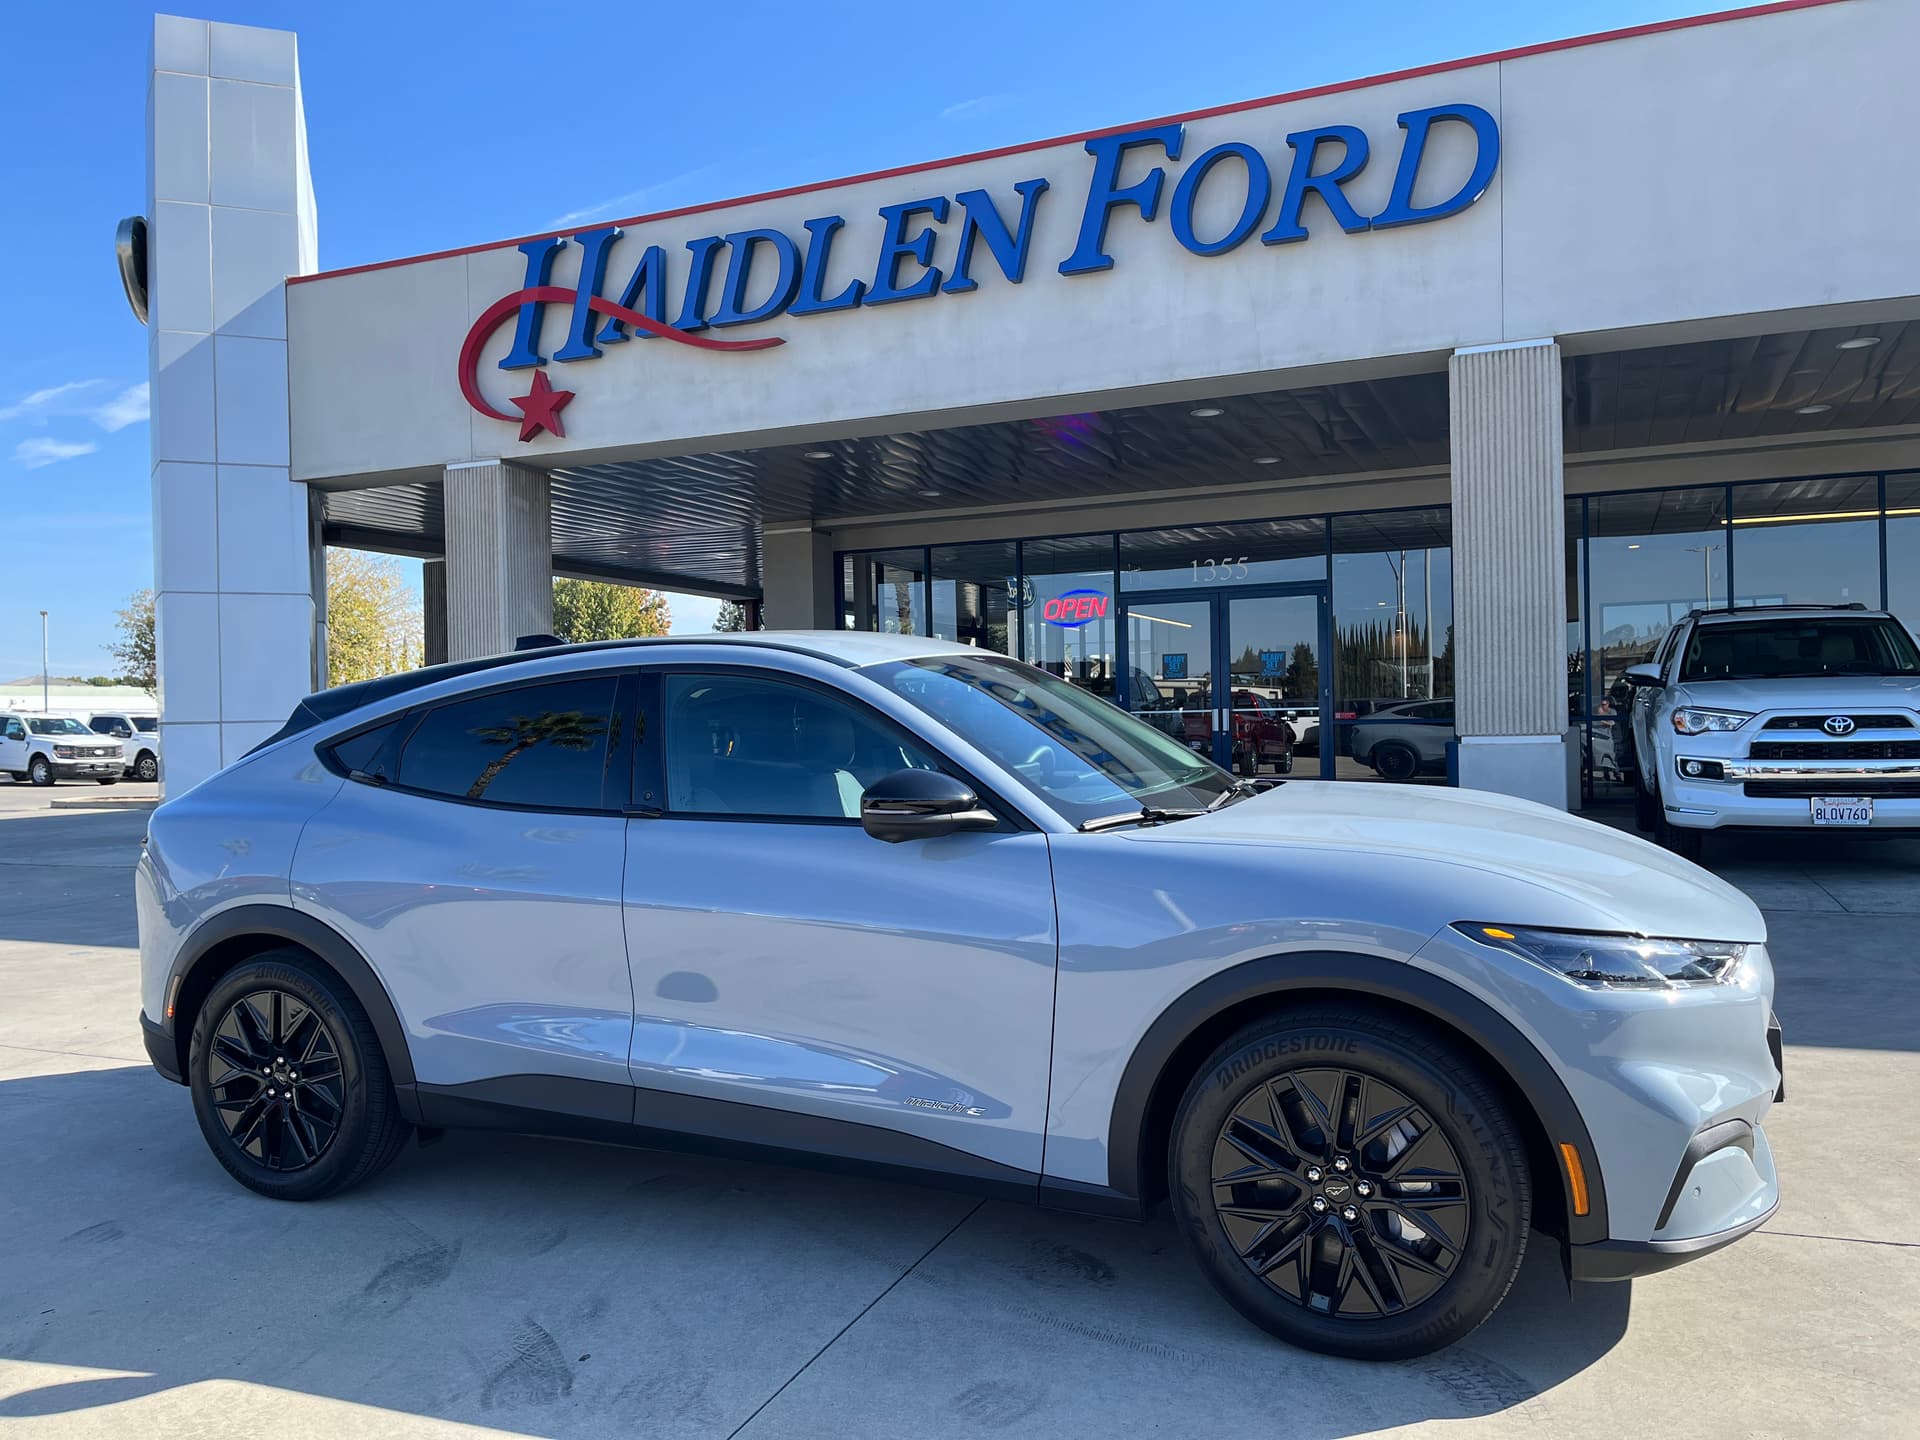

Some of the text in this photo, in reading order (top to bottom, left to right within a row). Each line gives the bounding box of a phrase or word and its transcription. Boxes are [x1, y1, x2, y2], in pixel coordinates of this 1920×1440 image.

[498, 103, 1501, 370] HAIDLEN FORD
[1190, 556, 1249, 583] 1355
[1043, 595, 1109, 620] OPEN
[1461, 1112, 1508, 1208] ALENZA
